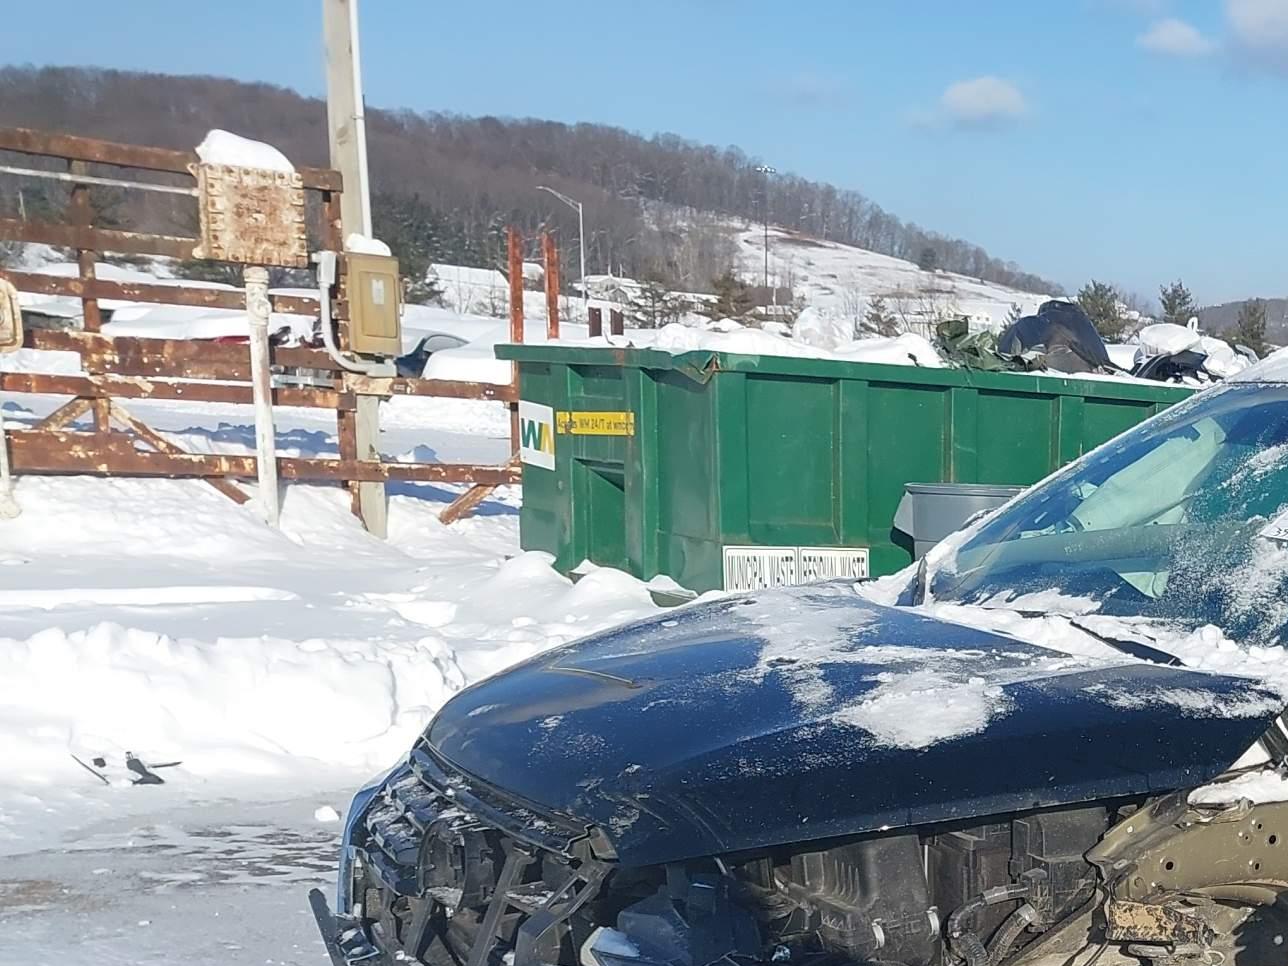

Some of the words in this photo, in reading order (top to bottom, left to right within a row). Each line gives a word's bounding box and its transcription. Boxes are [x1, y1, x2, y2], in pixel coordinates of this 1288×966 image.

[728, 555, 767, 590] MUNICIPAL
[768, 555, 794, 587] WASTE
[839, 556, 865, 577] WASTE
